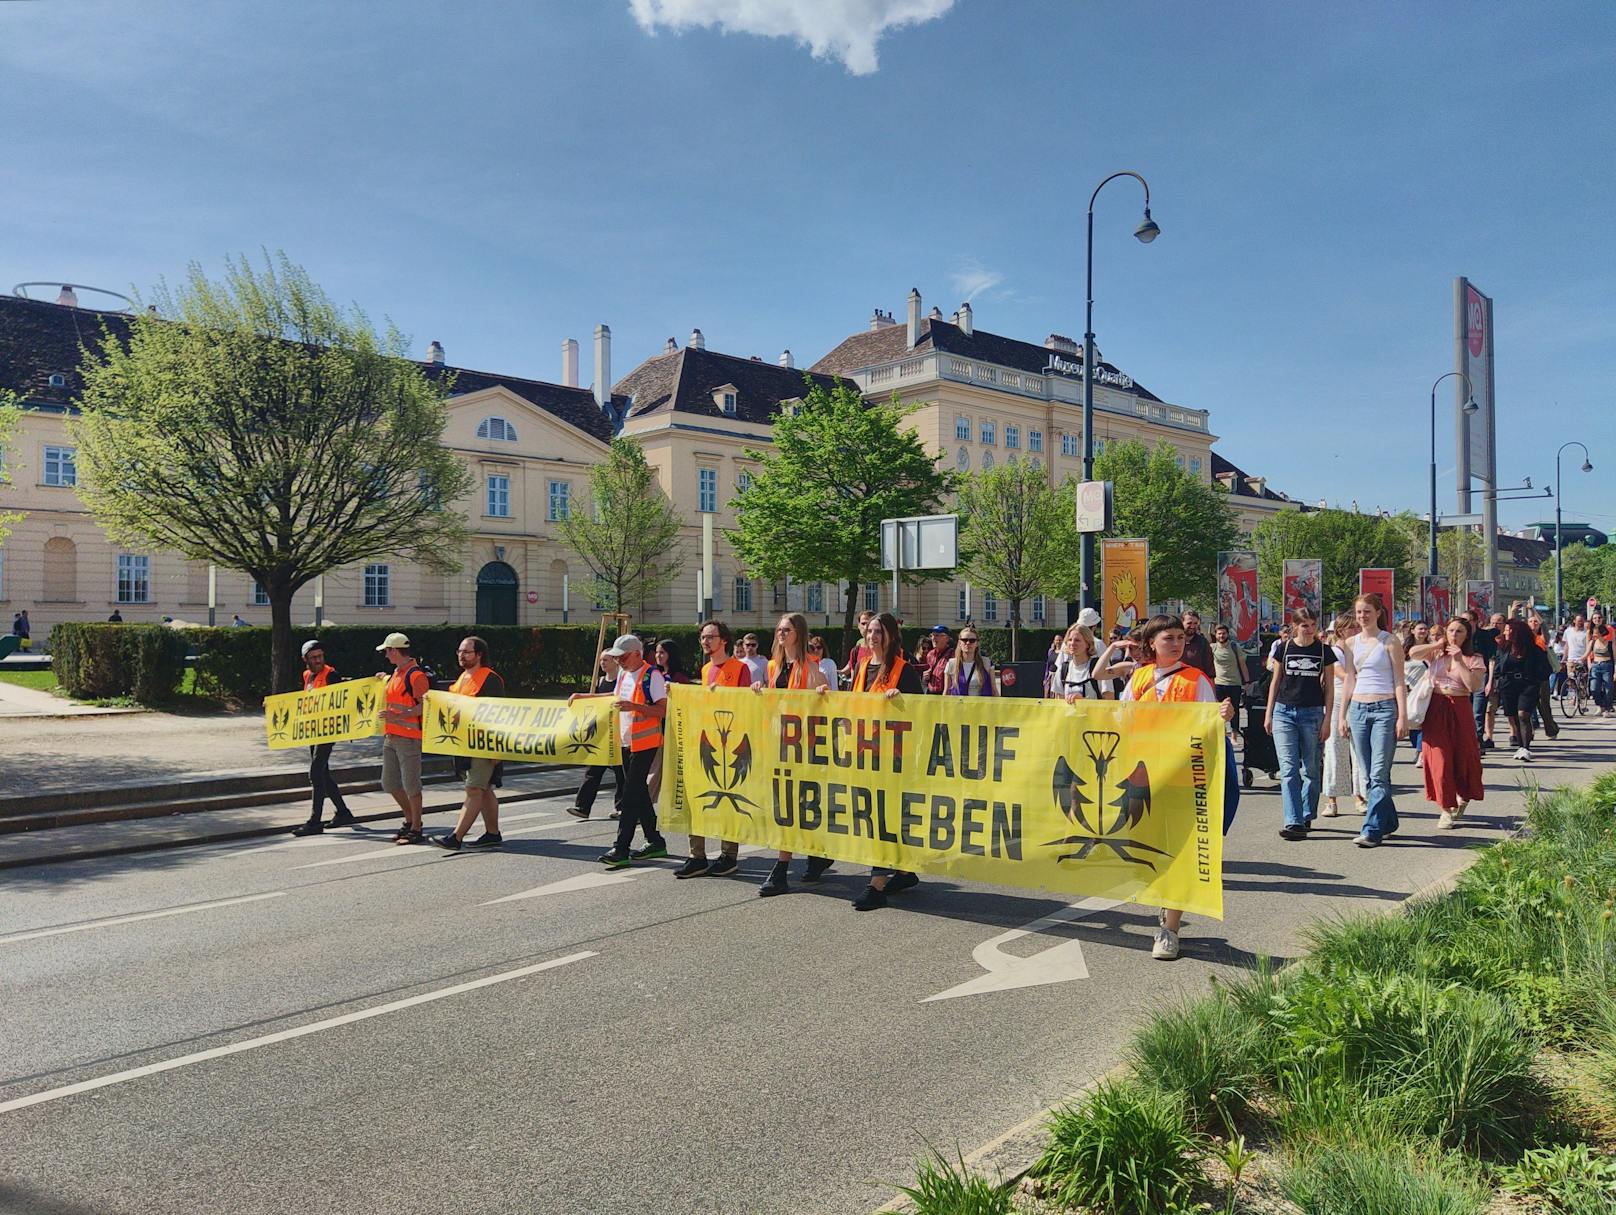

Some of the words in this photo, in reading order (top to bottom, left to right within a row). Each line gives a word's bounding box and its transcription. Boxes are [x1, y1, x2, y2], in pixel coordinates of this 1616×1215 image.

[296, 693, 326, 716] RECHT
[328, 689, 348, 709] AUF
[472, 703, 531, 725] RECHT
[531, 707, 567, 727] AUF
[292, 714, 350, 740] ÜBERLEBEN
[467, 724, 557, 756] ÜBERLEBEN
[779, 714, 913, 774] RECHT
[926, 723, 1020, 782] AUF
[675, 778, 684, 810] LETZTE
[1190, 735, 1209, 833] GENERATION.AT
[772, 768, 1023, 861] ÜBERLEBEN
[1197, 837, 1210, 883] LETZTE
